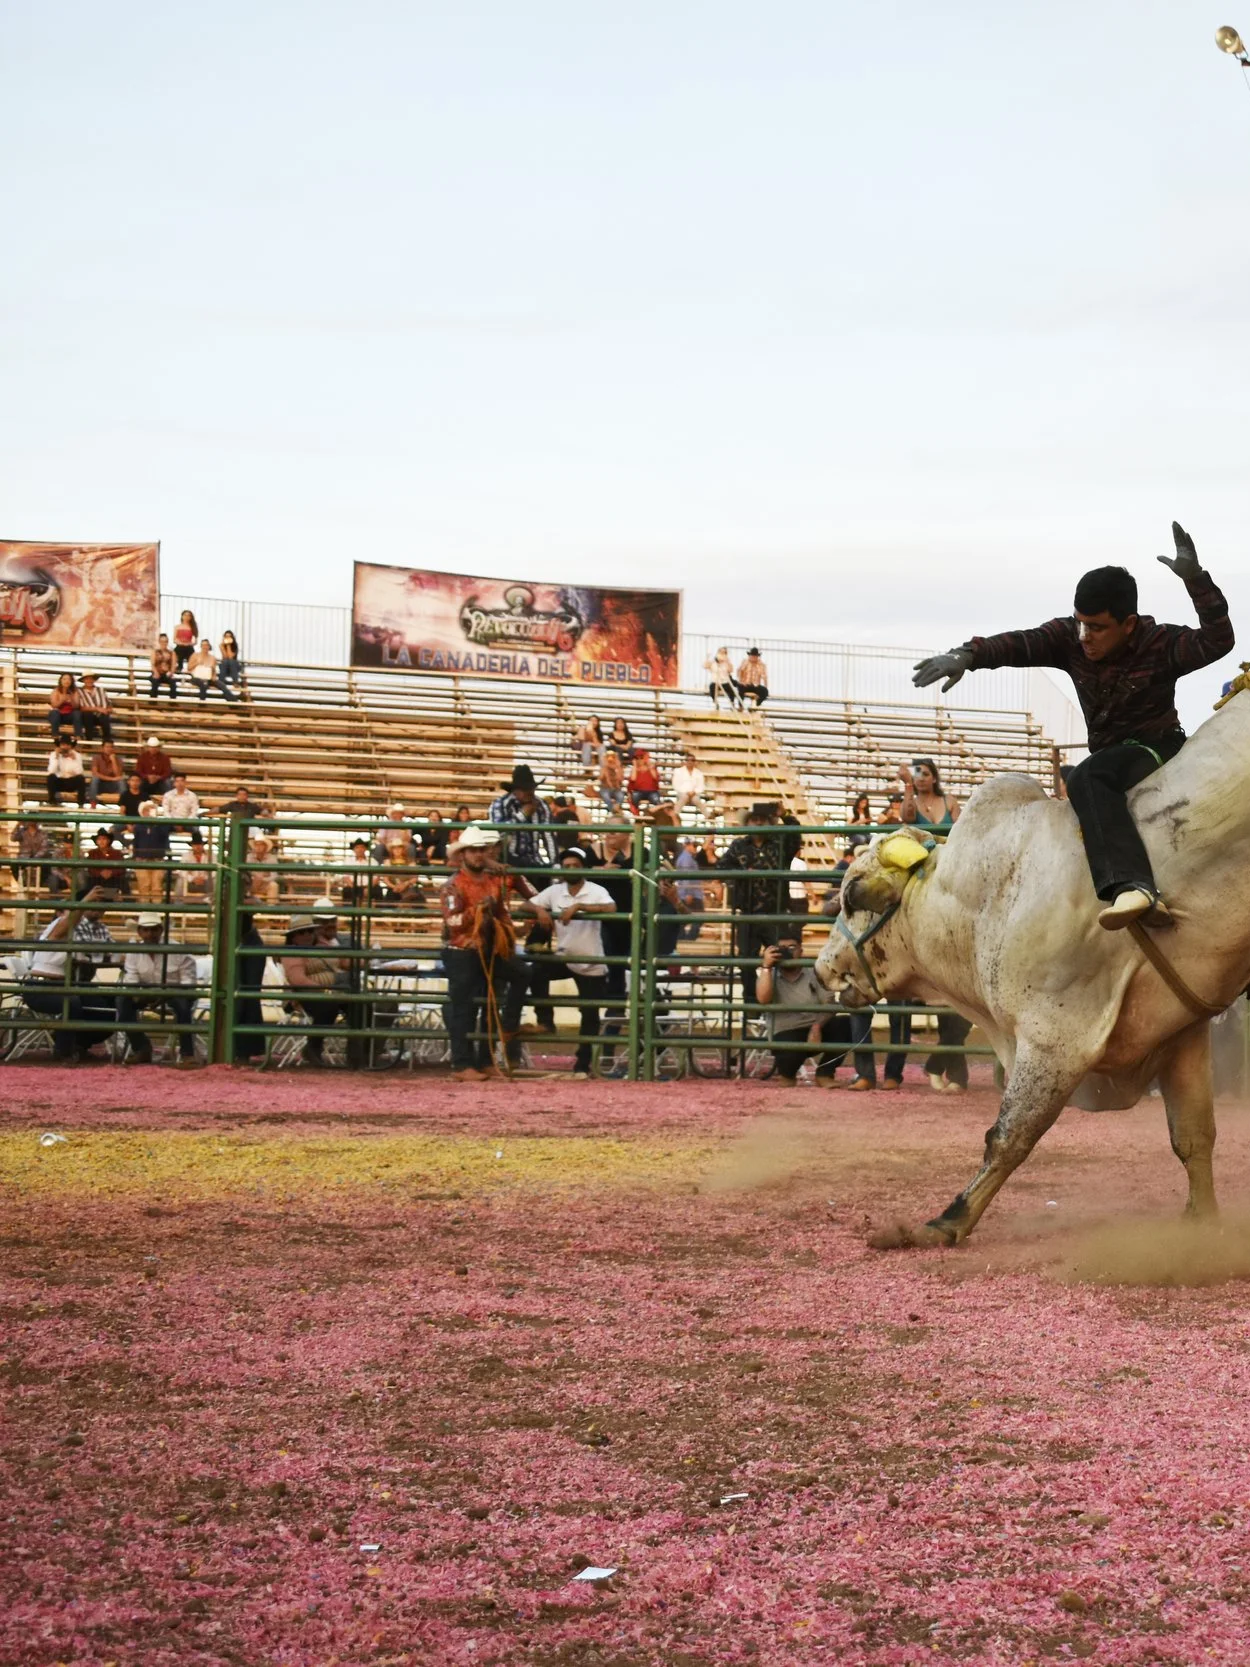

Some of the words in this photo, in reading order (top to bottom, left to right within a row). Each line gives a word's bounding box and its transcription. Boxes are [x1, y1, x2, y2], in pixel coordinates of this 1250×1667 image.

[382, 644, 411, 666] LA
[537, 657, 572, 679] DEL
[581, 661, 652, 684] PUEBLO
